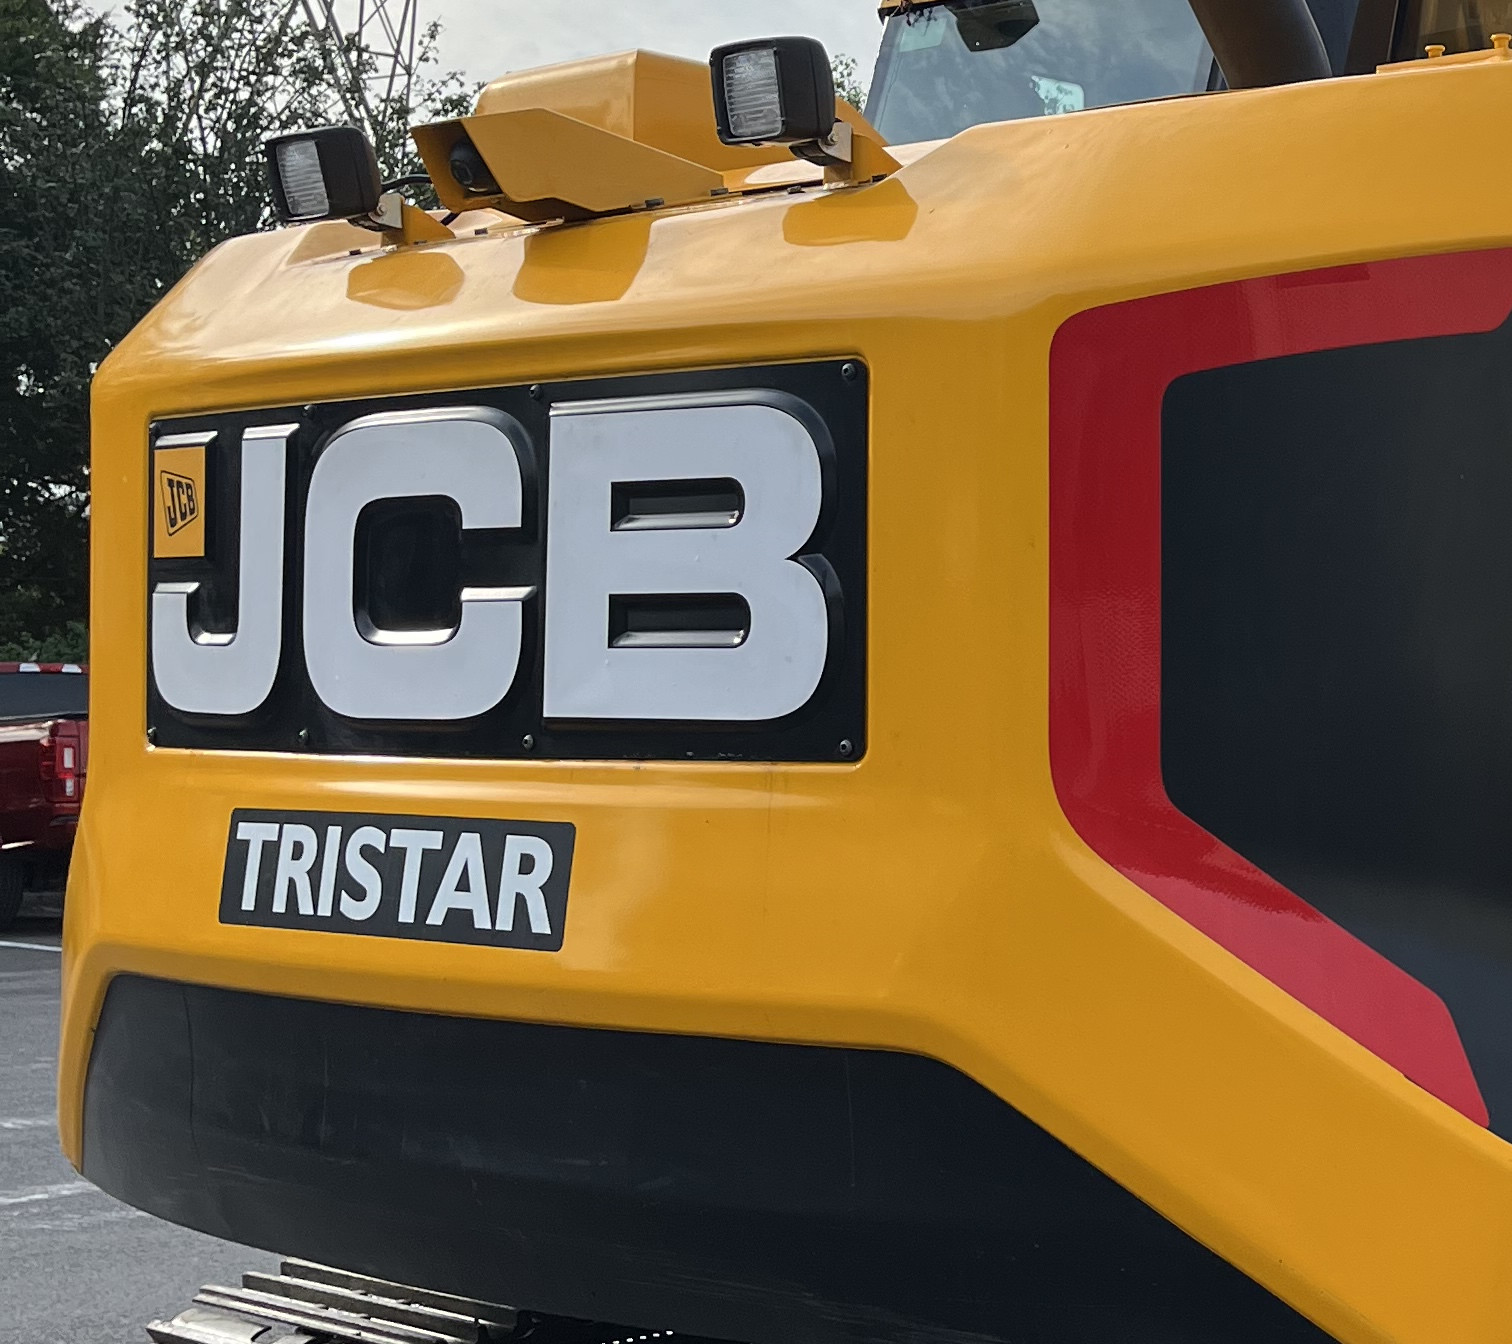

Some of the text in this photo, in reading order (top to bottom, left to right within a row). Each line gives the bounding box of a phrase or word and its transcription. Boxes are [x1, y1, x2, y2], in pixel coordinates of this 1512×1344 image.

[152, 389, 838, 722] JCB
[166, 477, 196, 528] JCB
[235, 821, 554, 936] TRISTAR
